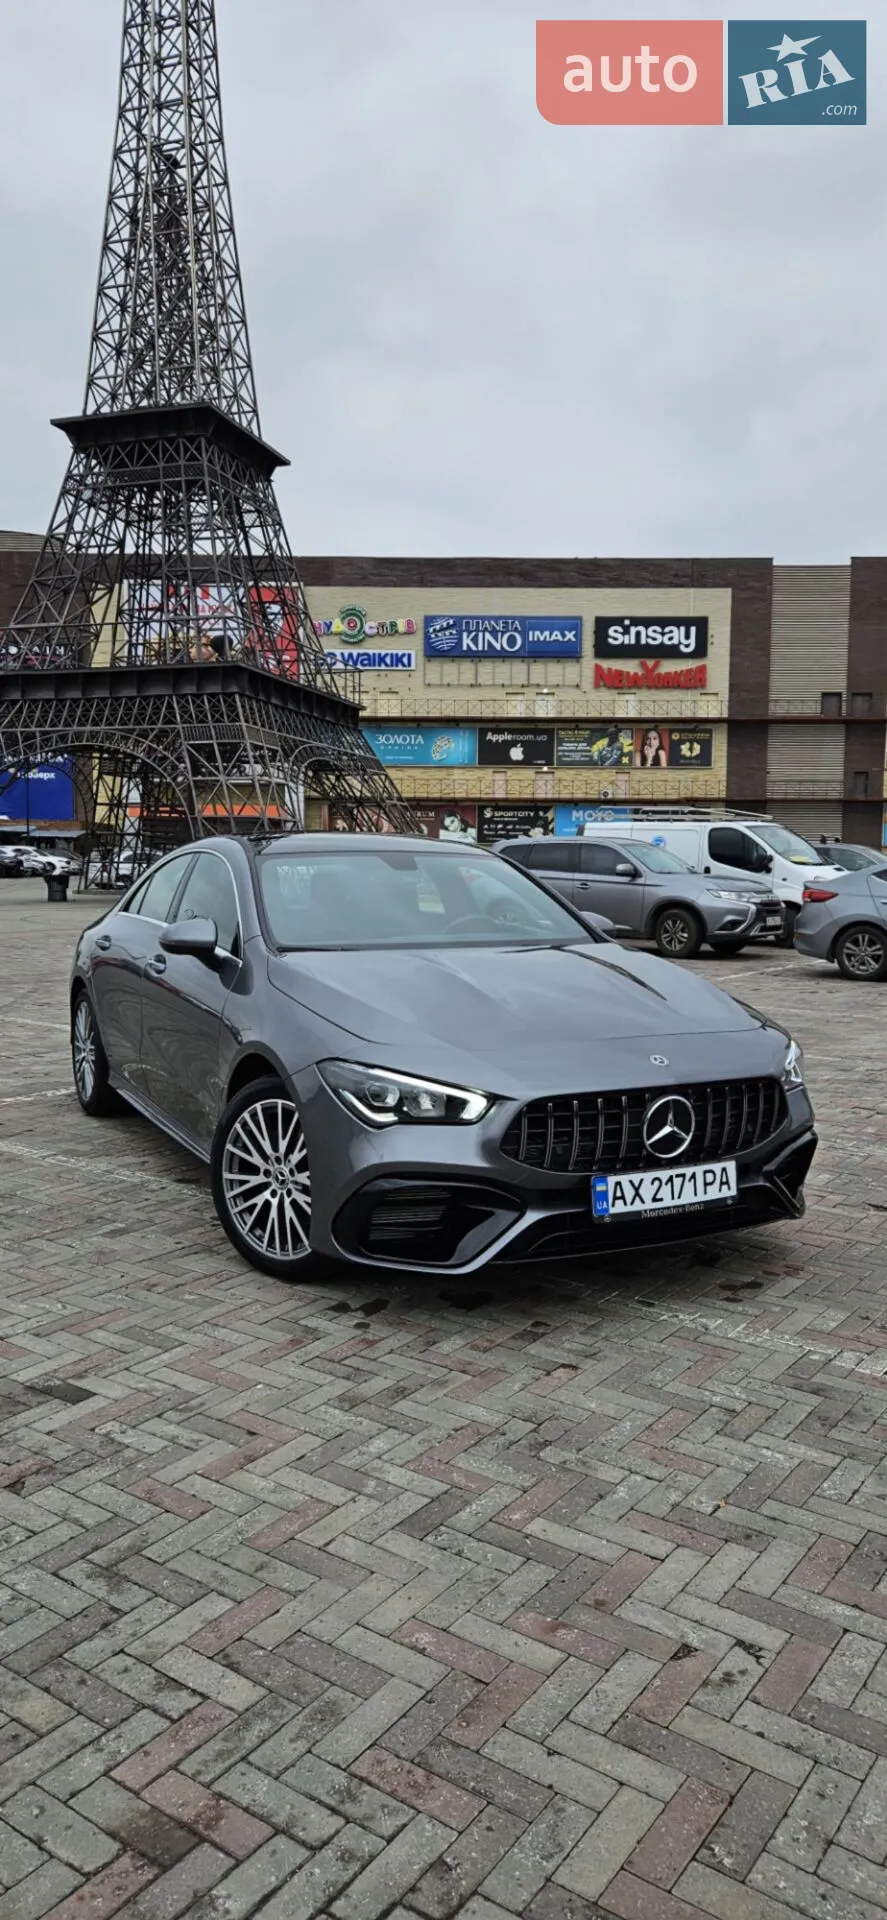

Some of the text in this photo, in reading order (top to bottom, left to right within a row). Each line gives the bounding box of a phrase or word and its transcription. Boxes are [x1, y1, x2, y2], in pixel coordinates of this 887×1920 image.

[462, 631, 522, 652] KINO
[528, 630, 577, 642] IMAX
[607, 619, 697, 653] sinsay
[375, 734, 425, 745] ЗОЛОТА
[611, 1167, 731, 1208] AX 2171 PA
[596, 1200, 608, 1210] UA
